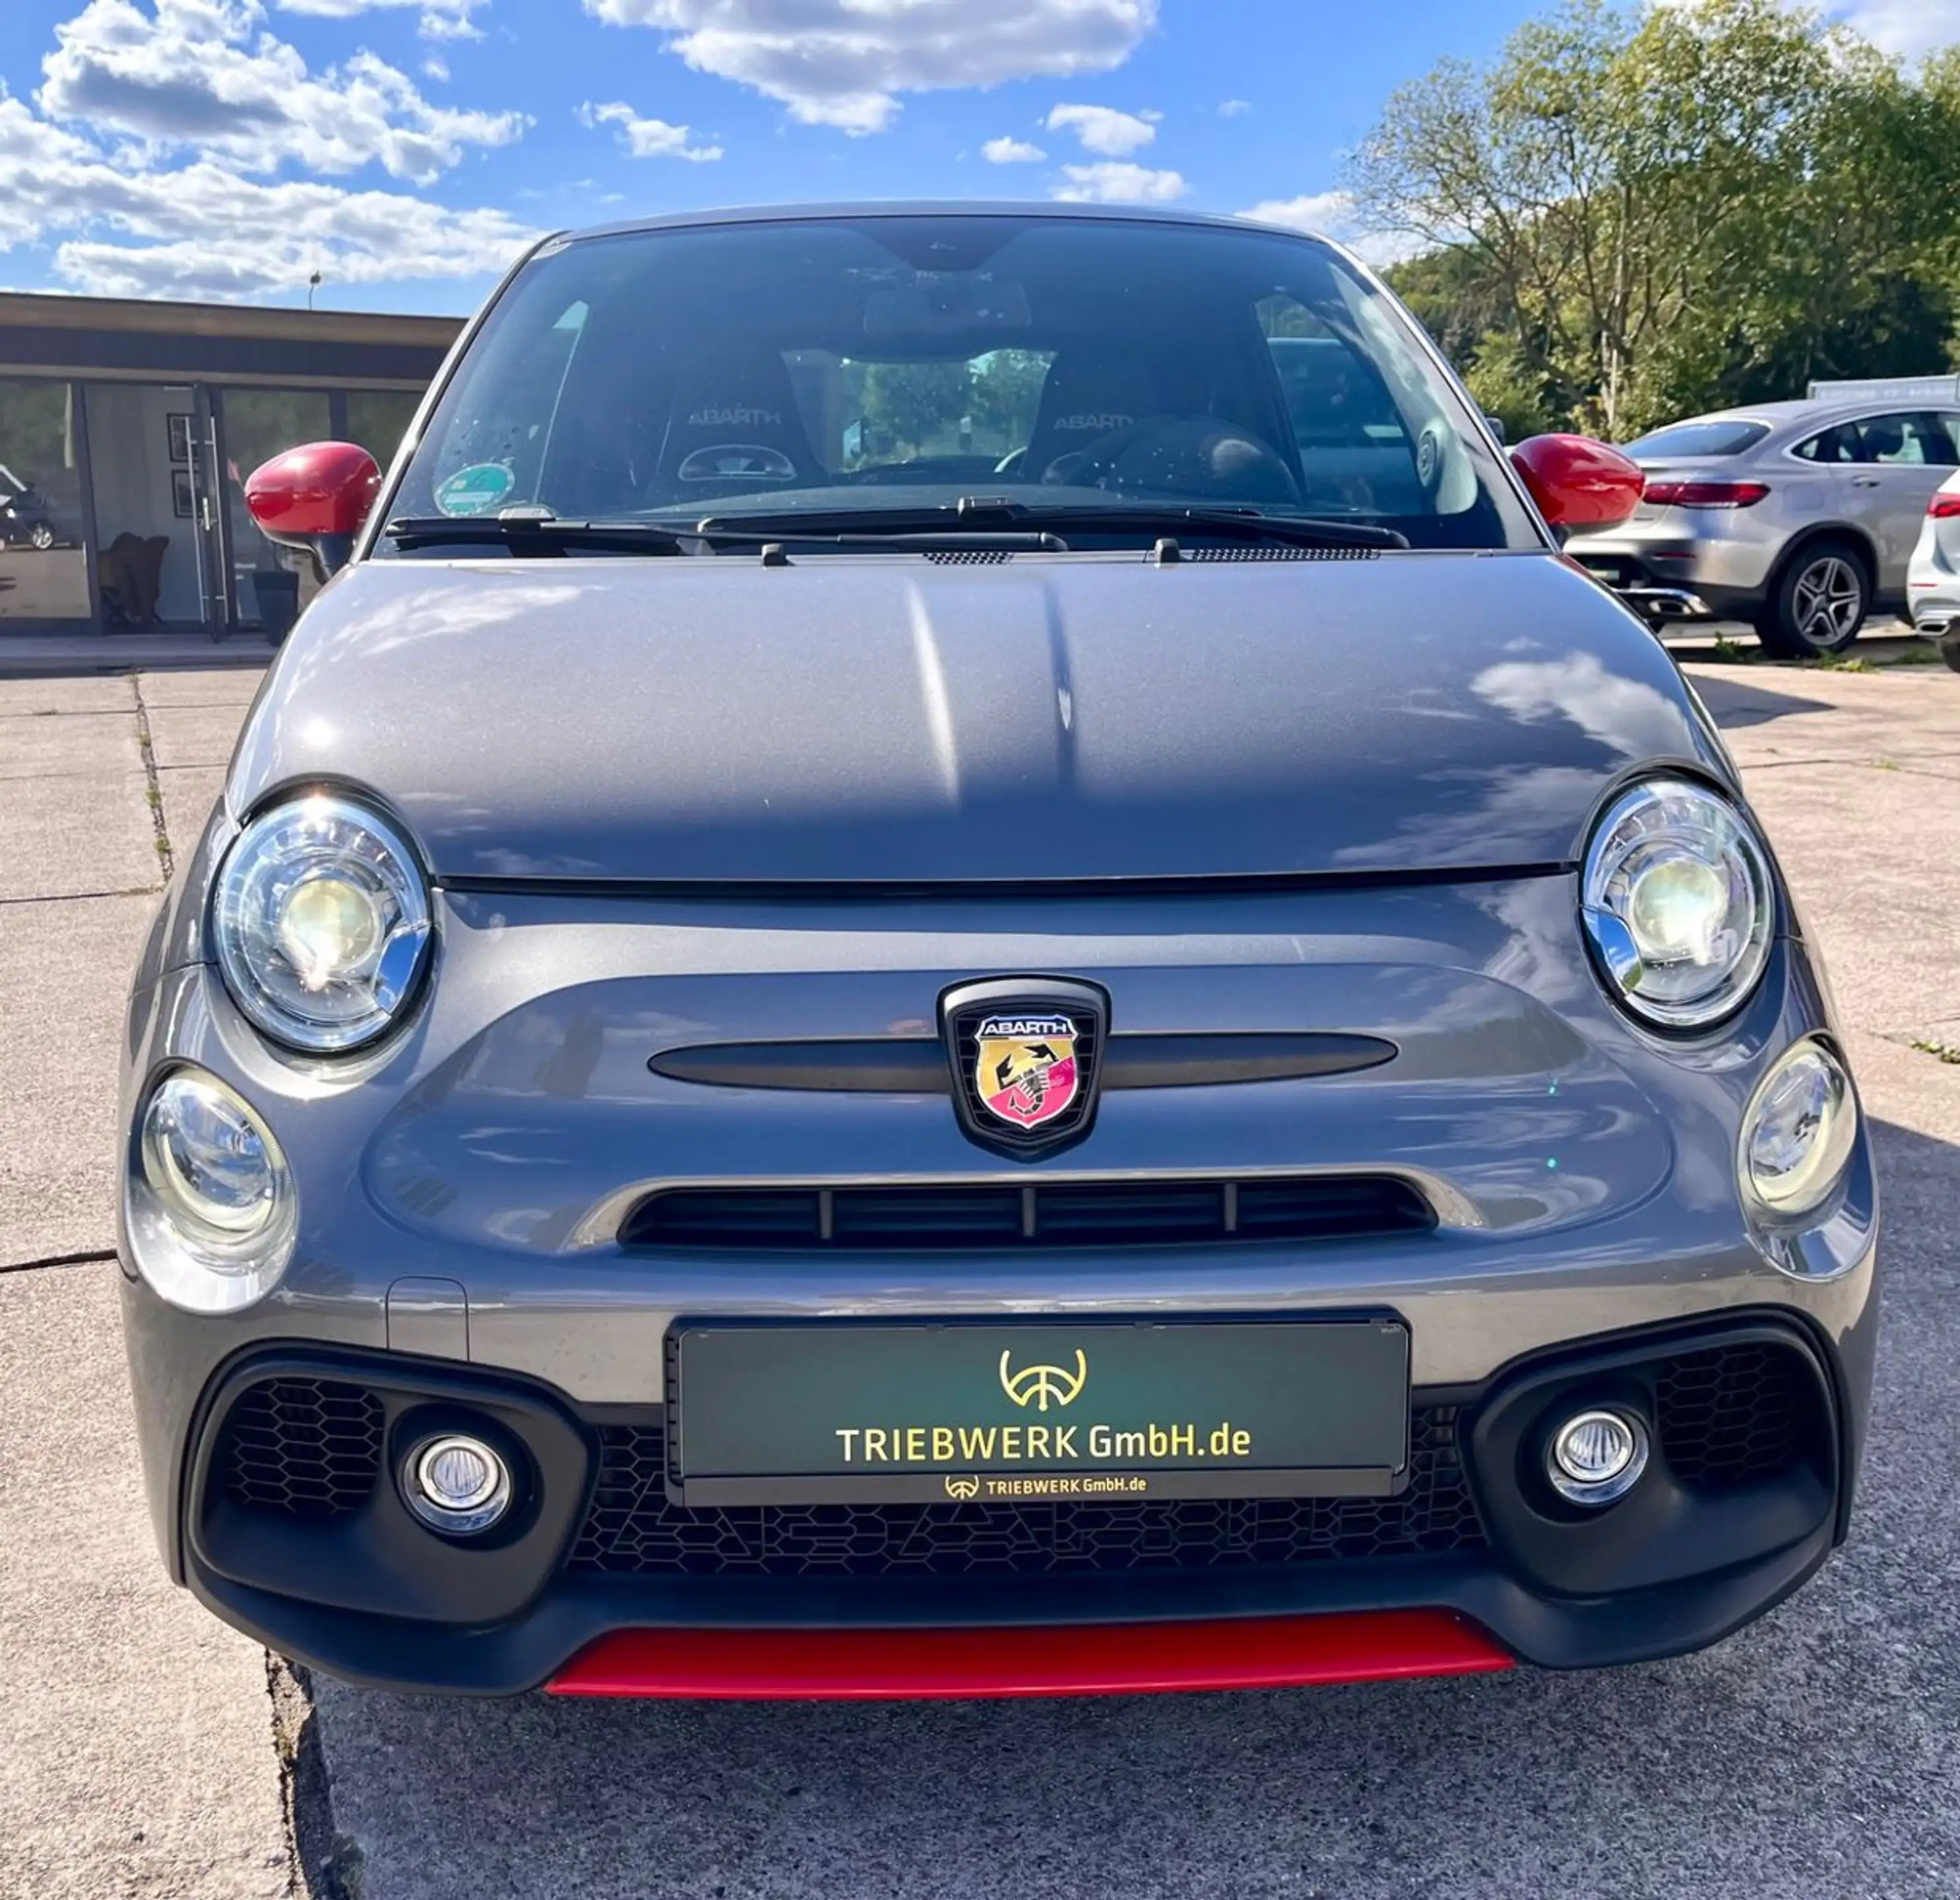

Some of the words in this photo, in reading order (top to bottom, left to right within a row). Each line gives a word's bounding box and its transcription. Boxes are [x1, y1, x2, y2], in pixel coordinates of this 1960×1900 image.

[687, 408, 781, 426] ABARTH
[984, 1021, 1067, 1035] ABARTH
[835, 1425, 1078, 1461] TRIEBWERK
[1089, 1422, 1249, 1457] GmbH.de
[986, 1478, 1080, 1494] TRIEBWERK
[1083, 1477, 1147, 1492] GmbH.de
